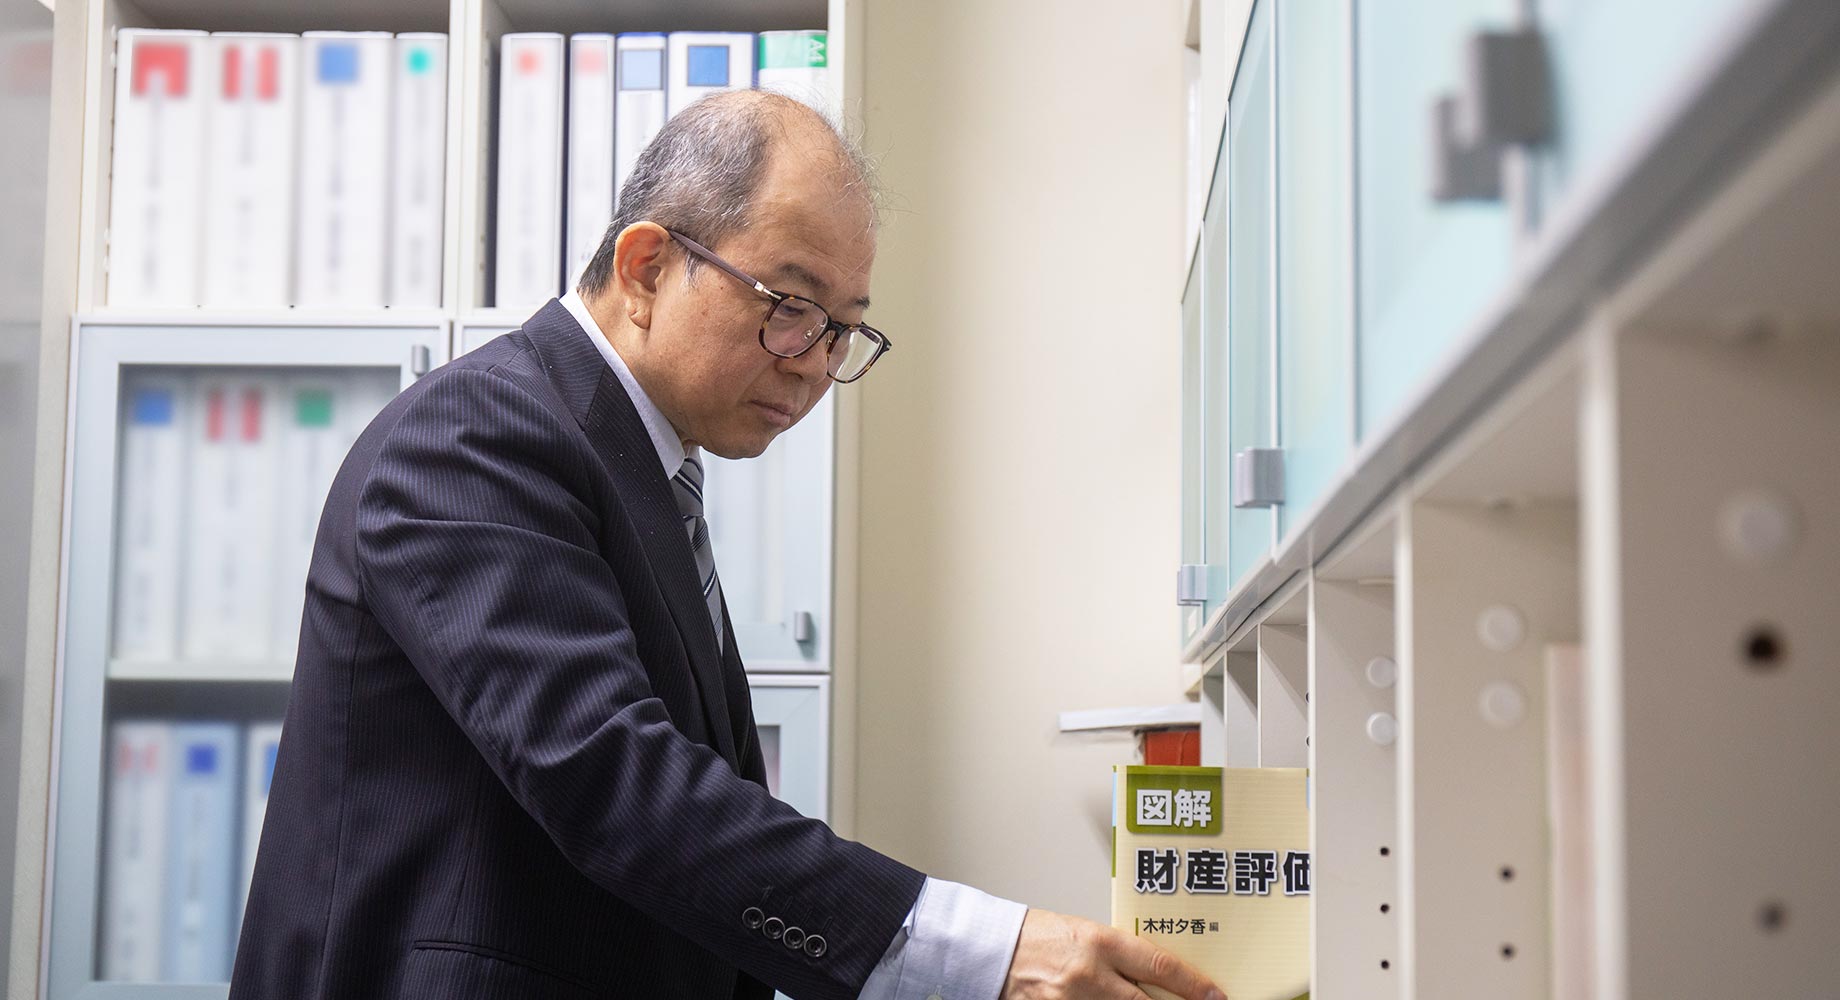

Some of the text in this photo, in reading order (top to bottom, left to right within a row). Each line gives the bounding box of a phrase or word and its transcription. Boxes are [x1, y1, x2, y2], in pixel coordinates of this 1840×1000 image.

[808, 38, 826, 63] A4
[1136, 788, 1212, 828] 図解
[1143, 917, 1206, 935] 木村夕香
